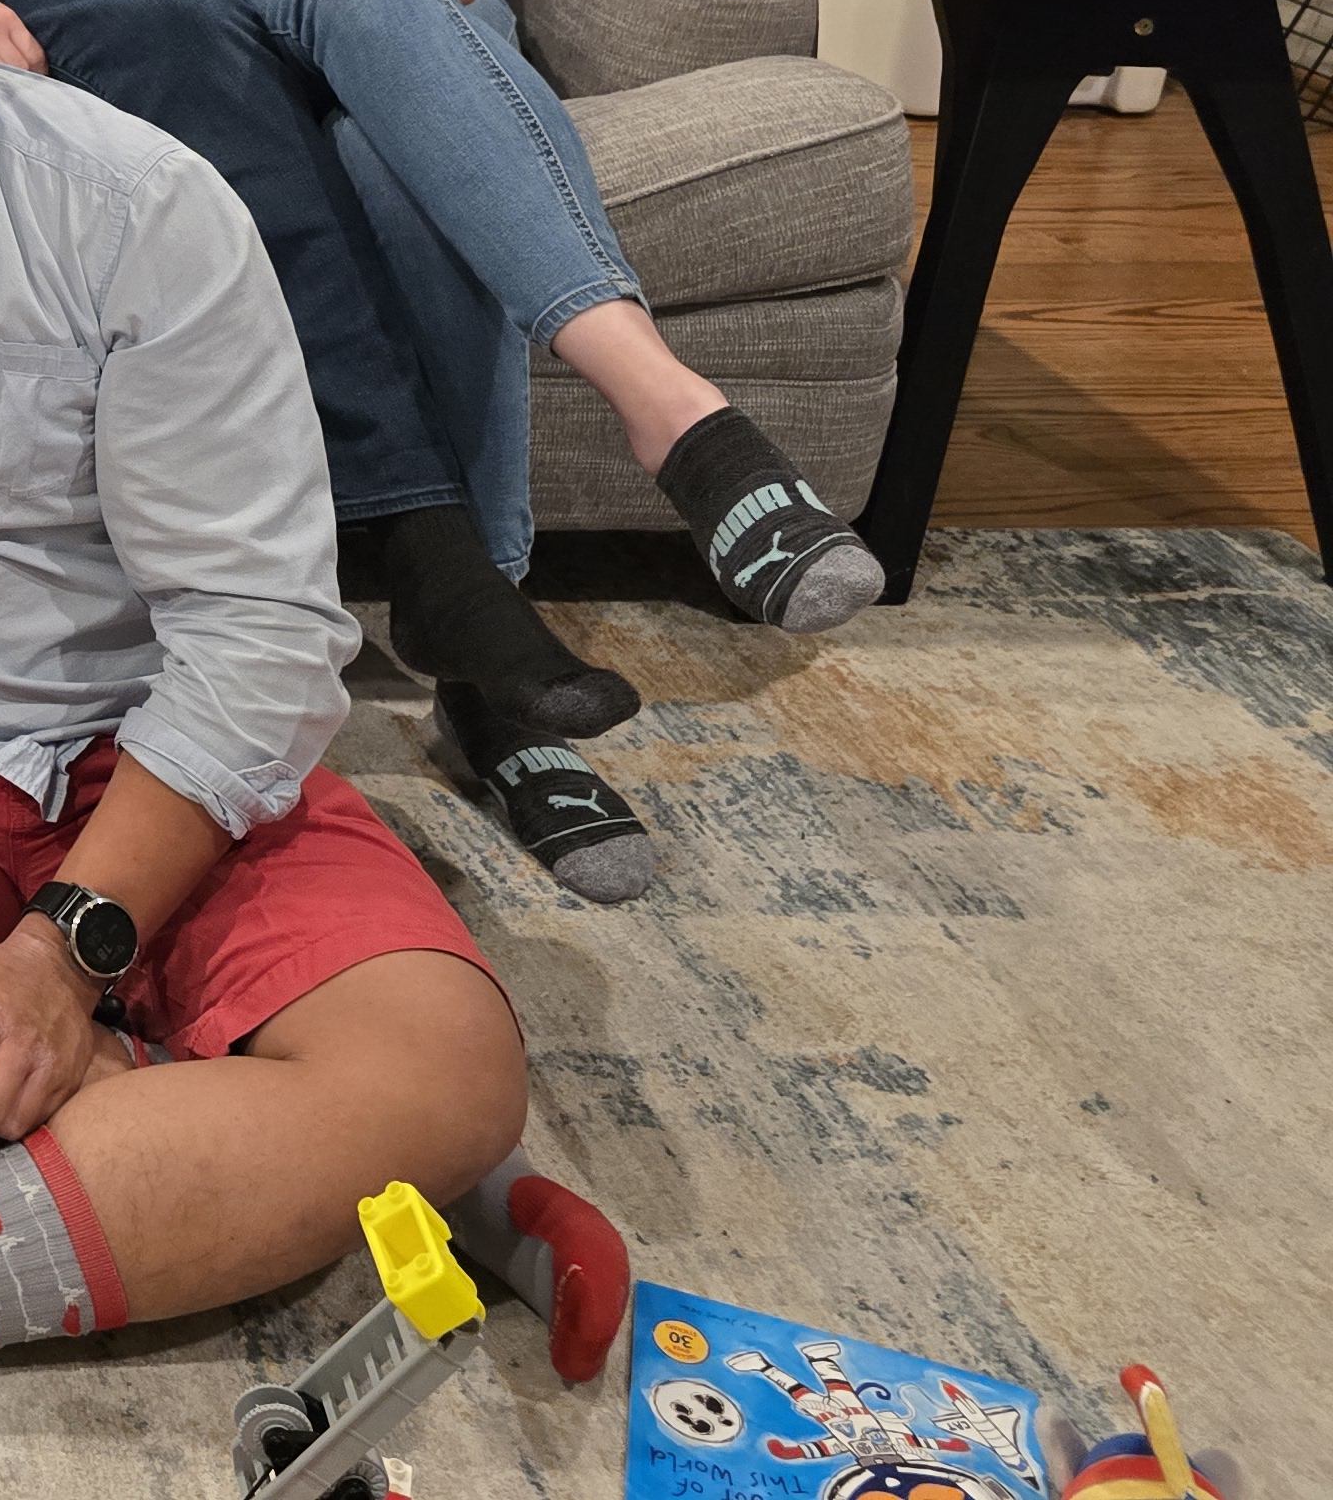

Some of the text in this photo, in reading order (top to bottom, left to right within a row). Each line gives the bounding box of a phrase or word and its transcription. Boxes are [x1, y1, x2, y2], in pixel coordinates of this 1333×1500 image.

[669, 1331, 694, 1349] 30
[946, 1420, 972, 1432] CAT
[649, 1446, 810, 1496] This World
[672, 1477, 704, 1497] of
